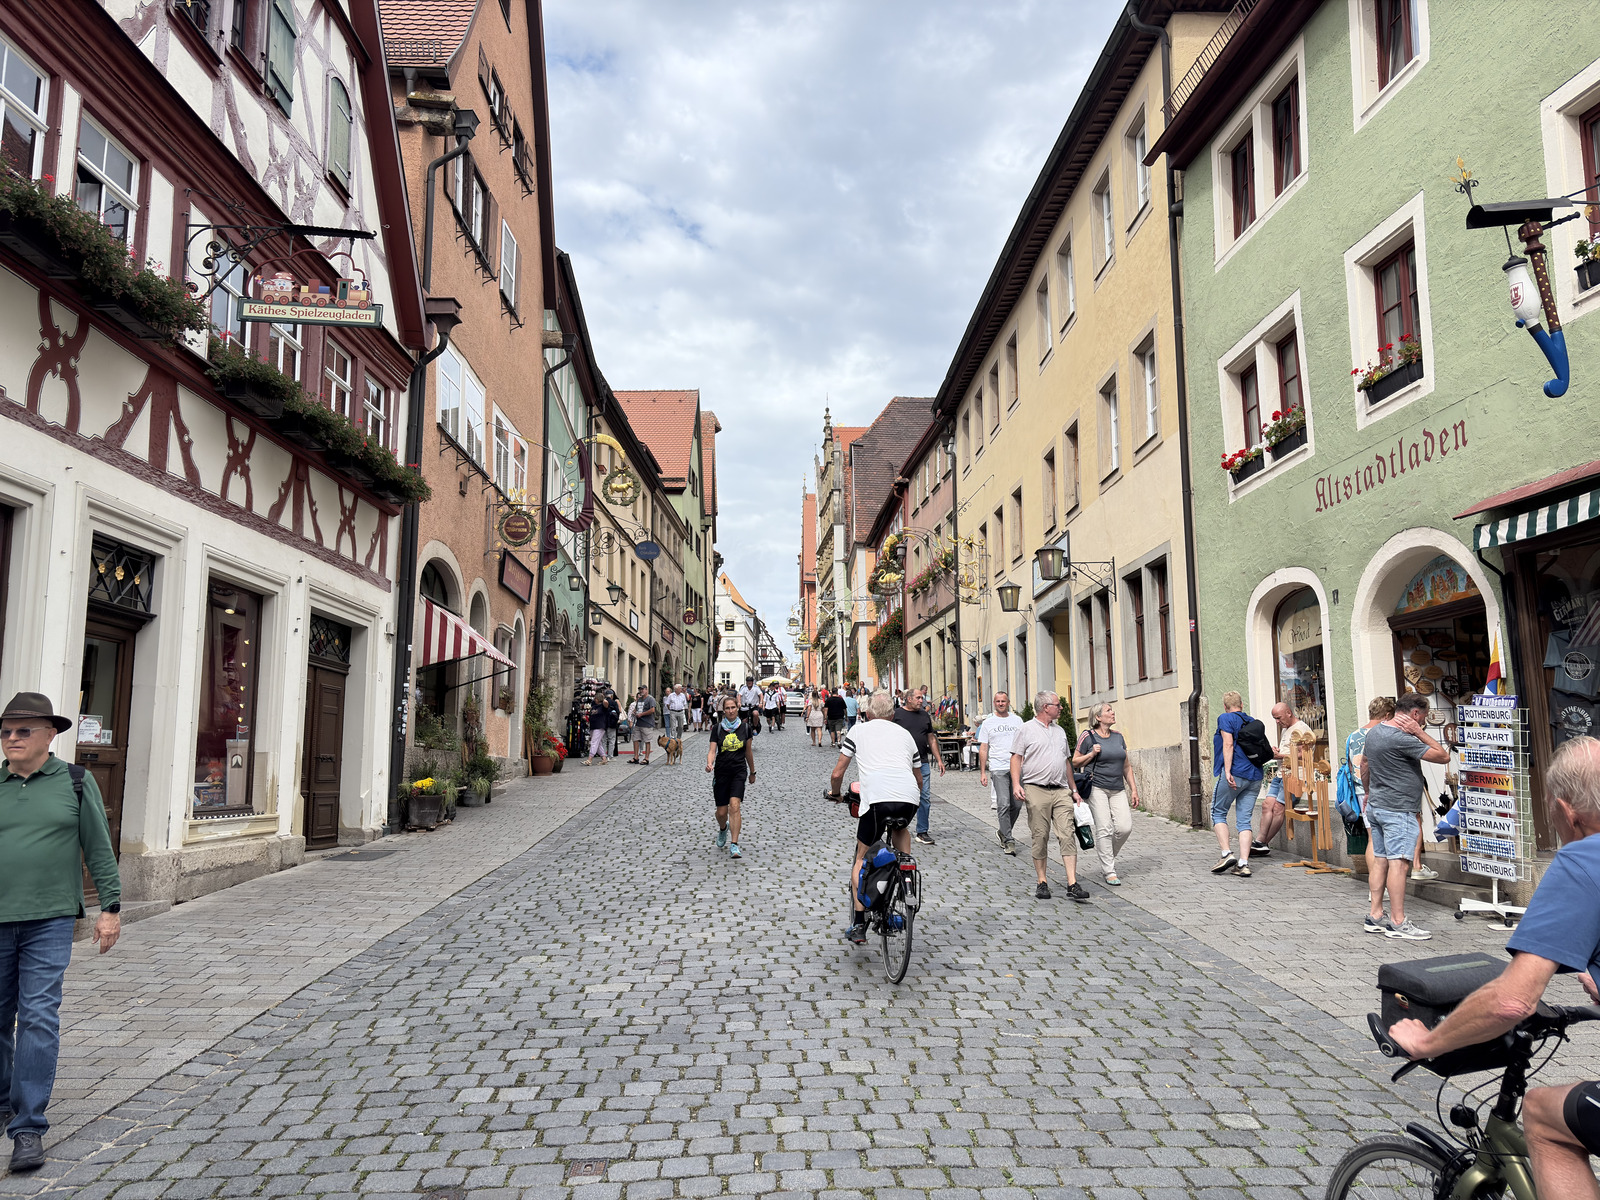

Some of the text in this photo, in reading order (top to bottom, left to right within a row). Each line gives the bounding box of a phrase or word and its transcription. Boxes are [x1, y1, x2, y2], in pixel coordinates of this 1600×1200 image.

[248, 304, 372, 321] Käthes Spielzeugladen
[1315, 419, 1468, 512] Altstadtladen
[1287, 622, 1310, 645] Wood
[1465, 709, 1511, 720] ROTHENBURG
[1466, 731, 1509, 742] AUSFAHRT
[1467, 751, 1510, 766] BIERGARTEN
[1467, 774, 1510, 787] GERMANY
[1466, 795, 1513, 810] DEUTSCHLAND
[1467, 817, 1511, 832] GERMANY
[1467, 860, 1514, 877] ROTHENBURG
